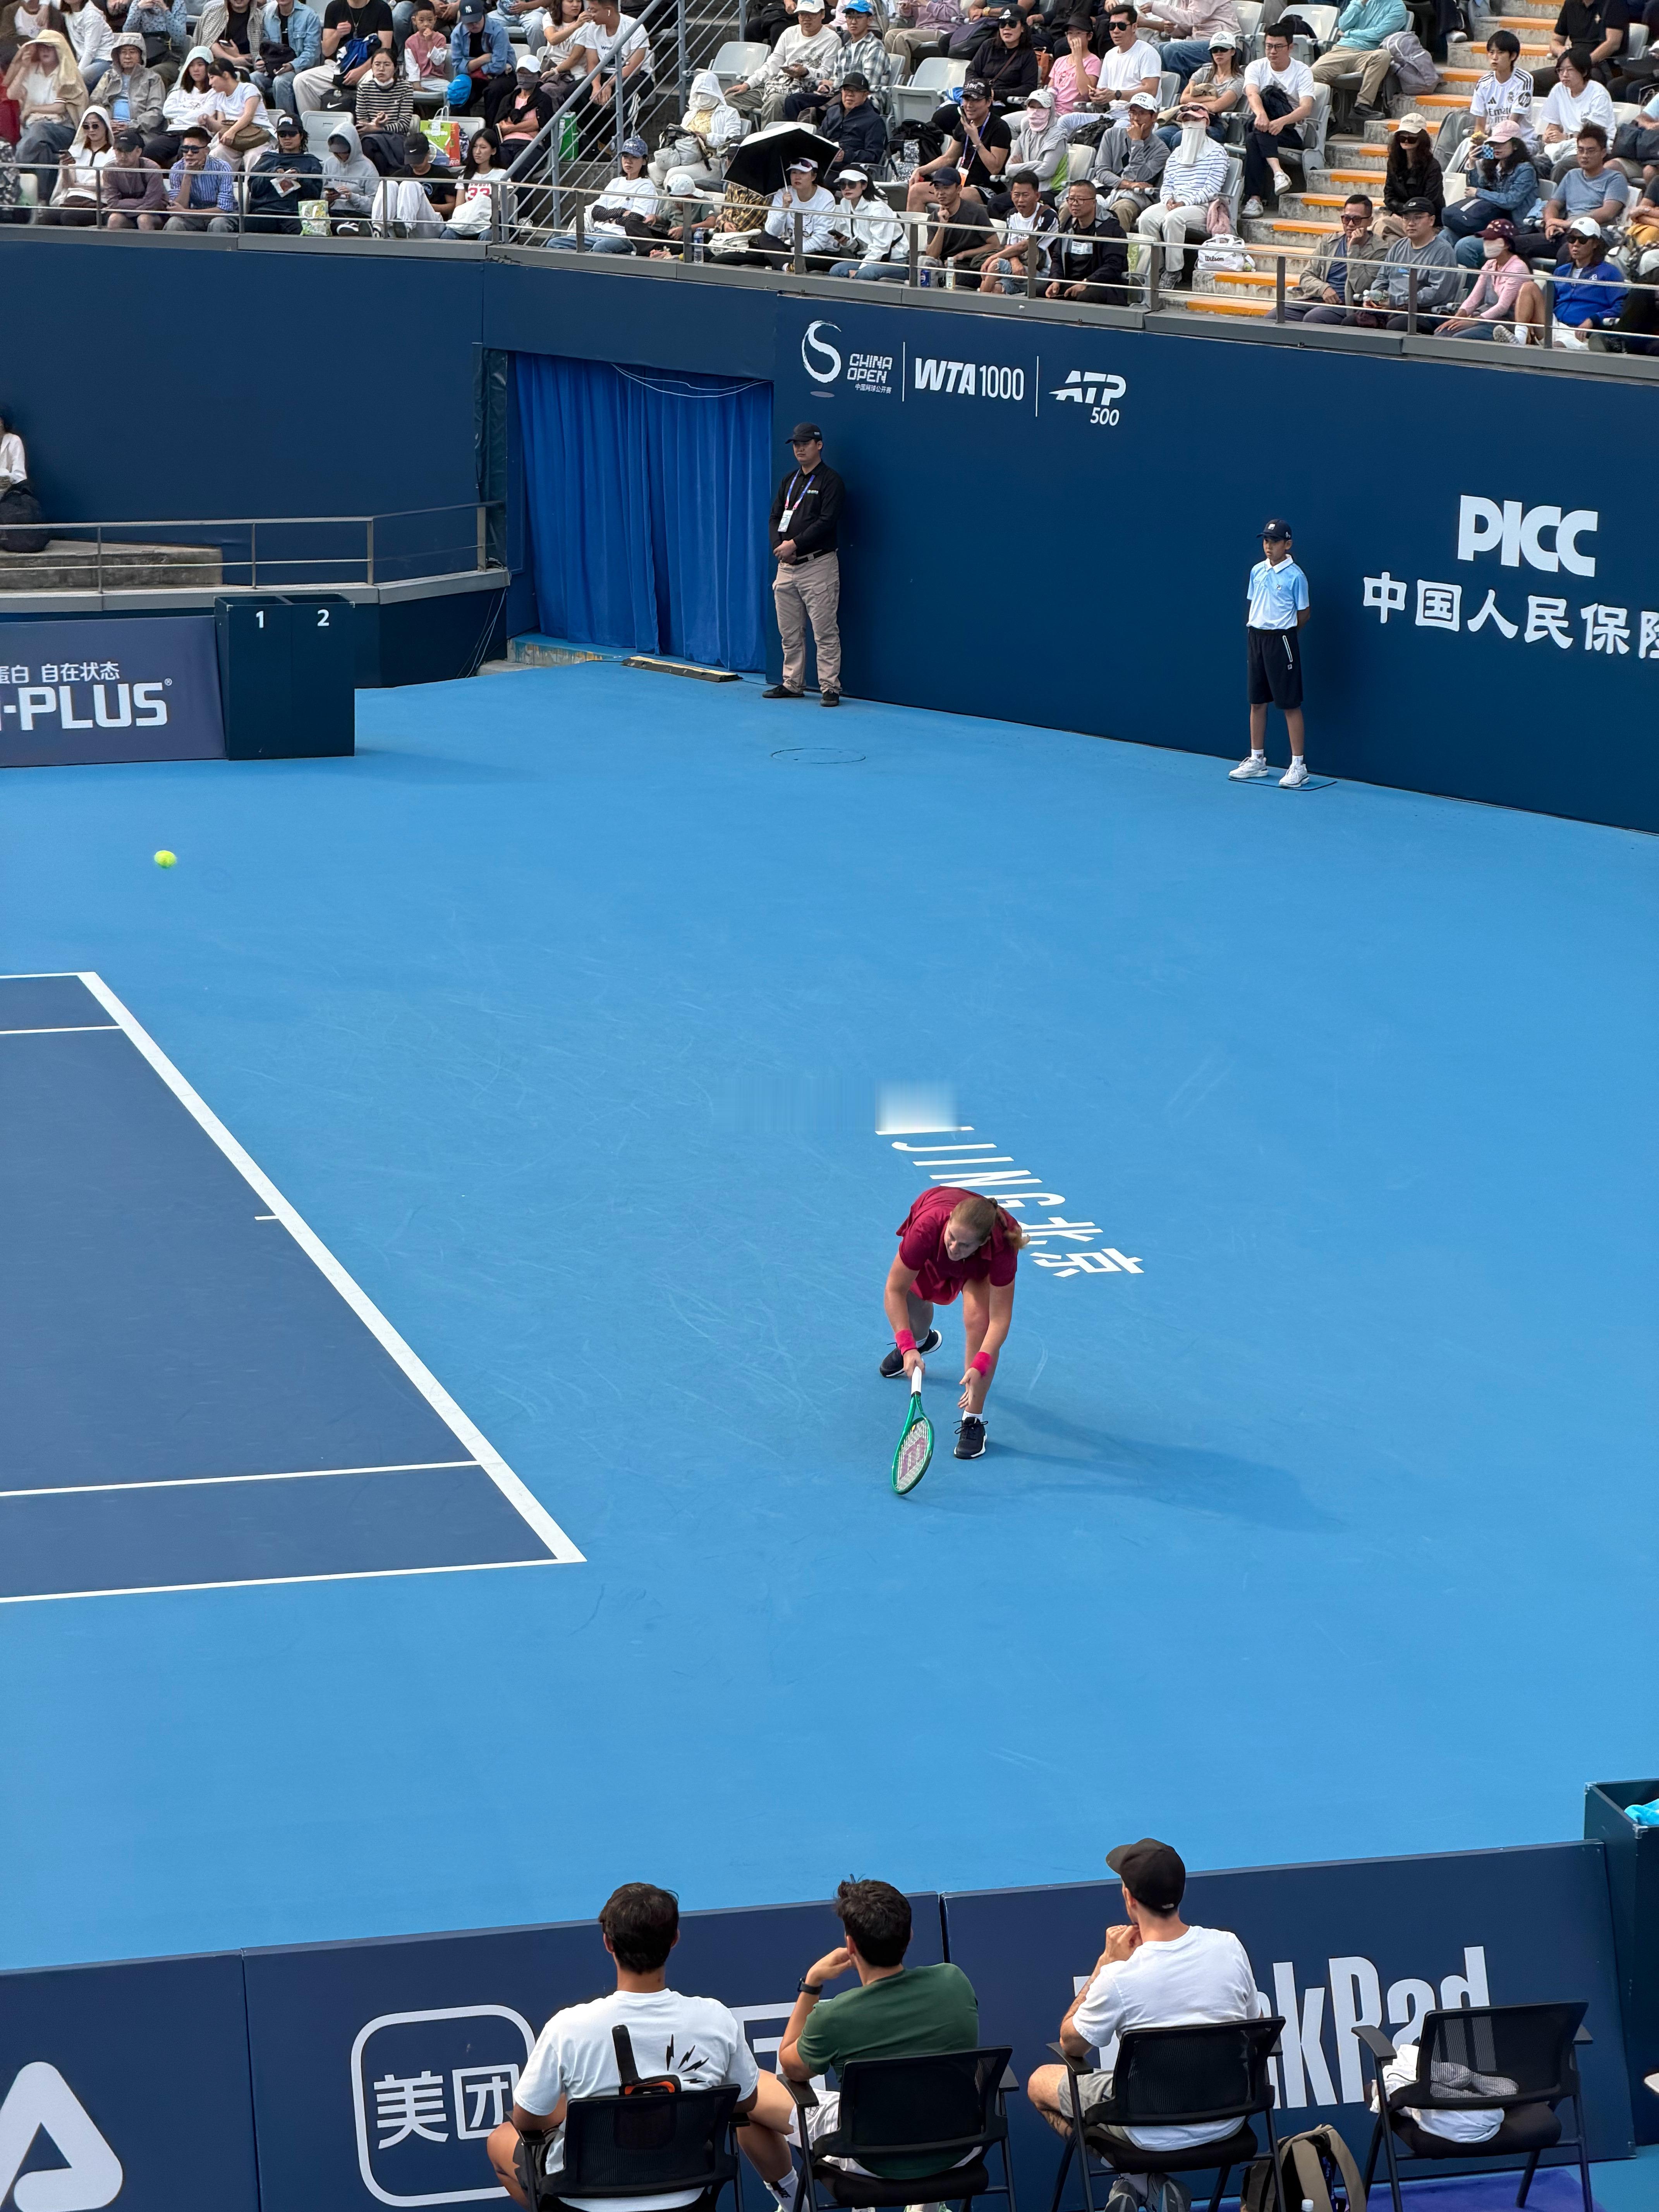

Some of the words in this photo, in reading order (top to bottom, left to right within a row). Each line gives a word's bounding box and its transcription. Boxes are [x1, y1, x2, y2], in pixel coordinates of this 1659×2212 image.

[850, 353, 893, 370] CHINA
[847, 367, 887, 384] OPEN
[915, 357, 976, 395] WTA
[979, 365, 1024, 401] 1000
[855, 383, 892, 394] 中国网球公开赛
[1048, 370, 1127, 406] ATP
[1090, 407, 1120, 426] 500
[1457, 495, 1599, 577] PICC
[256, 610, 265, 629] 1
[317, 609, 330, 627] 2
[41, 661, 120, 683] 自在状态
[374, 2063, 520, 2150] 美团
